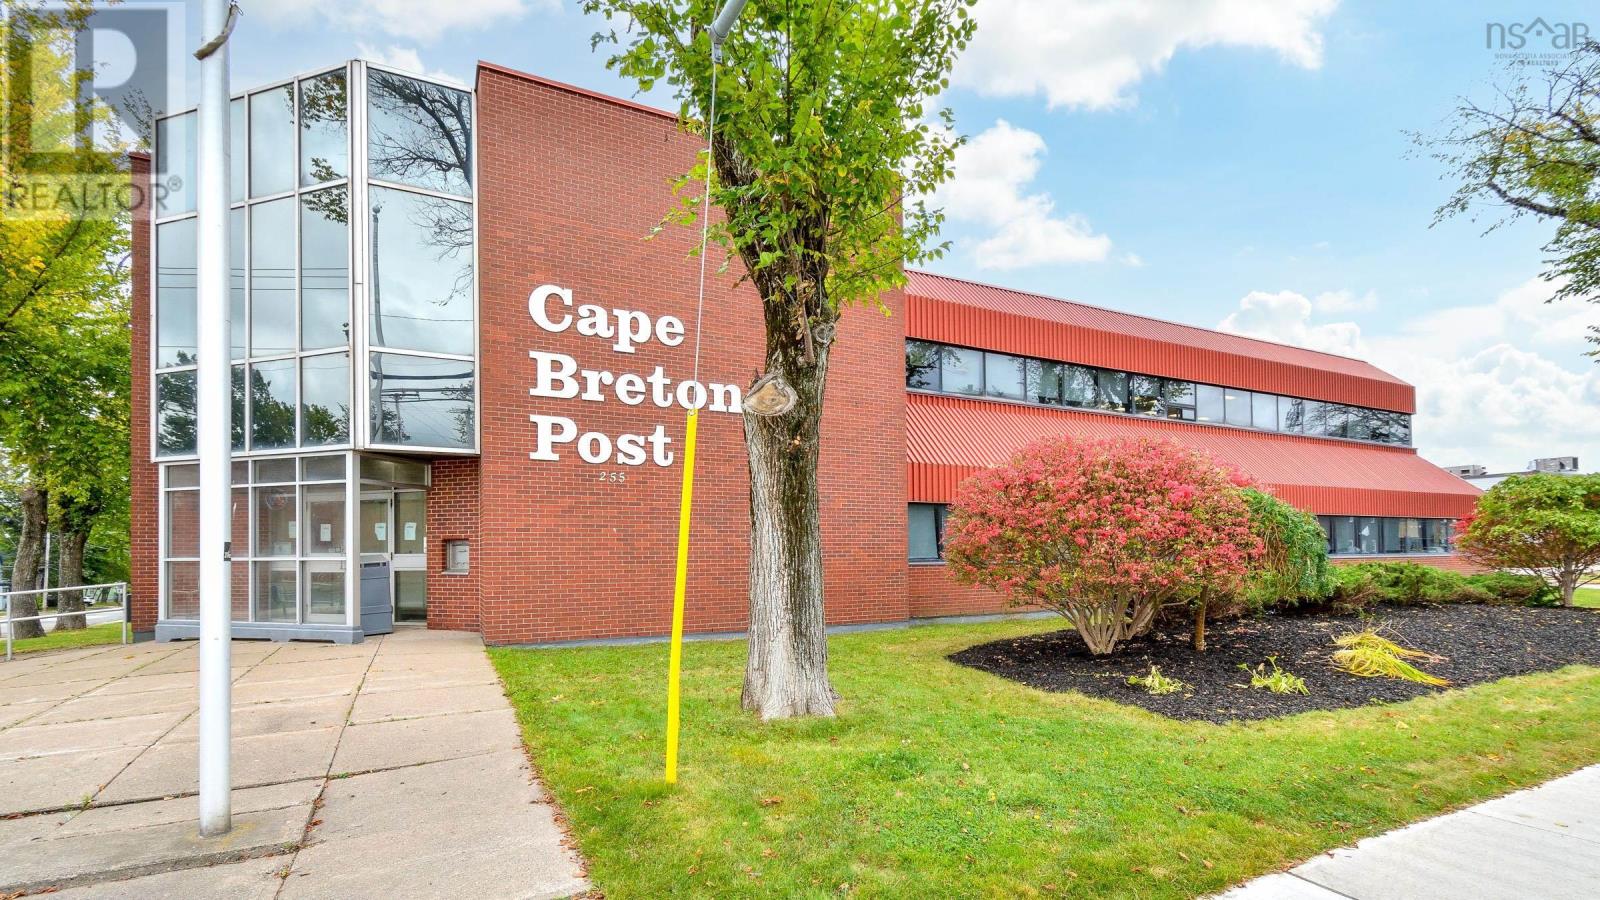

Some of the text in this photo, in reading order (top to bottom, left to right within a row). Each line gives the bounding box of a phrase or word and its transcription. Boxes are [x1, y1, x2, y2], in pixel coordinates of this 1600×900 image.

[528, 284, 685, 353] Cape
[528, 351, 743, 414] Breton
[529, 414, 674, 467] Post
[599, 471, 625, 483] 255
